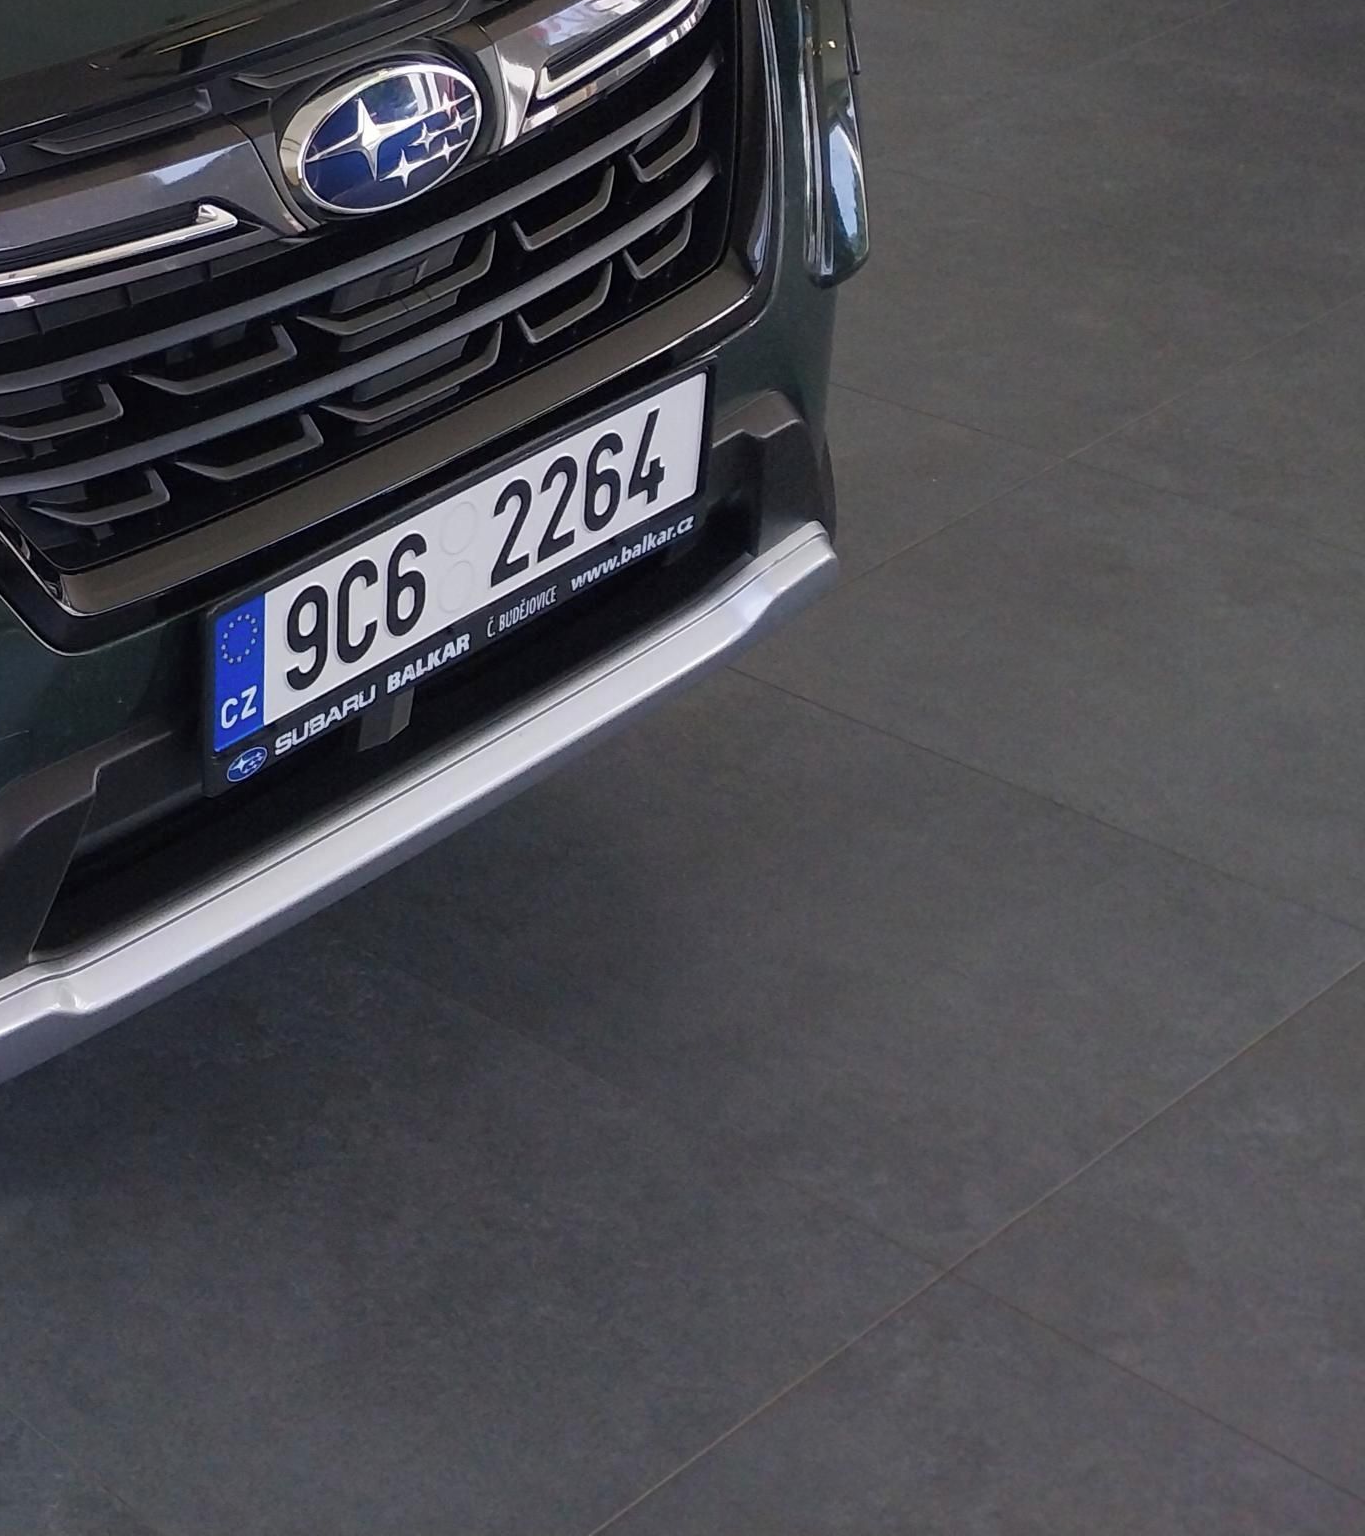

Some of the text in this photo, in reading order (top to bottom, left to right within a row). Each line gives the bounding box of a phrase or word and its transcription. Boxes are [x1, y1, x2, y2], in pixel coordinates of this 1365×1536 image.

[274, 684, 376, 756] SUBARU
[386, 633, 470, 694] BALKAR
[498, 585, 558, 632] BUDĚJOVICE
[570, 515, 695, 592] www.balkar.cz
[285, 407, 665, 691] 9C6 2264
[220, 684, 258, 730] CZ
